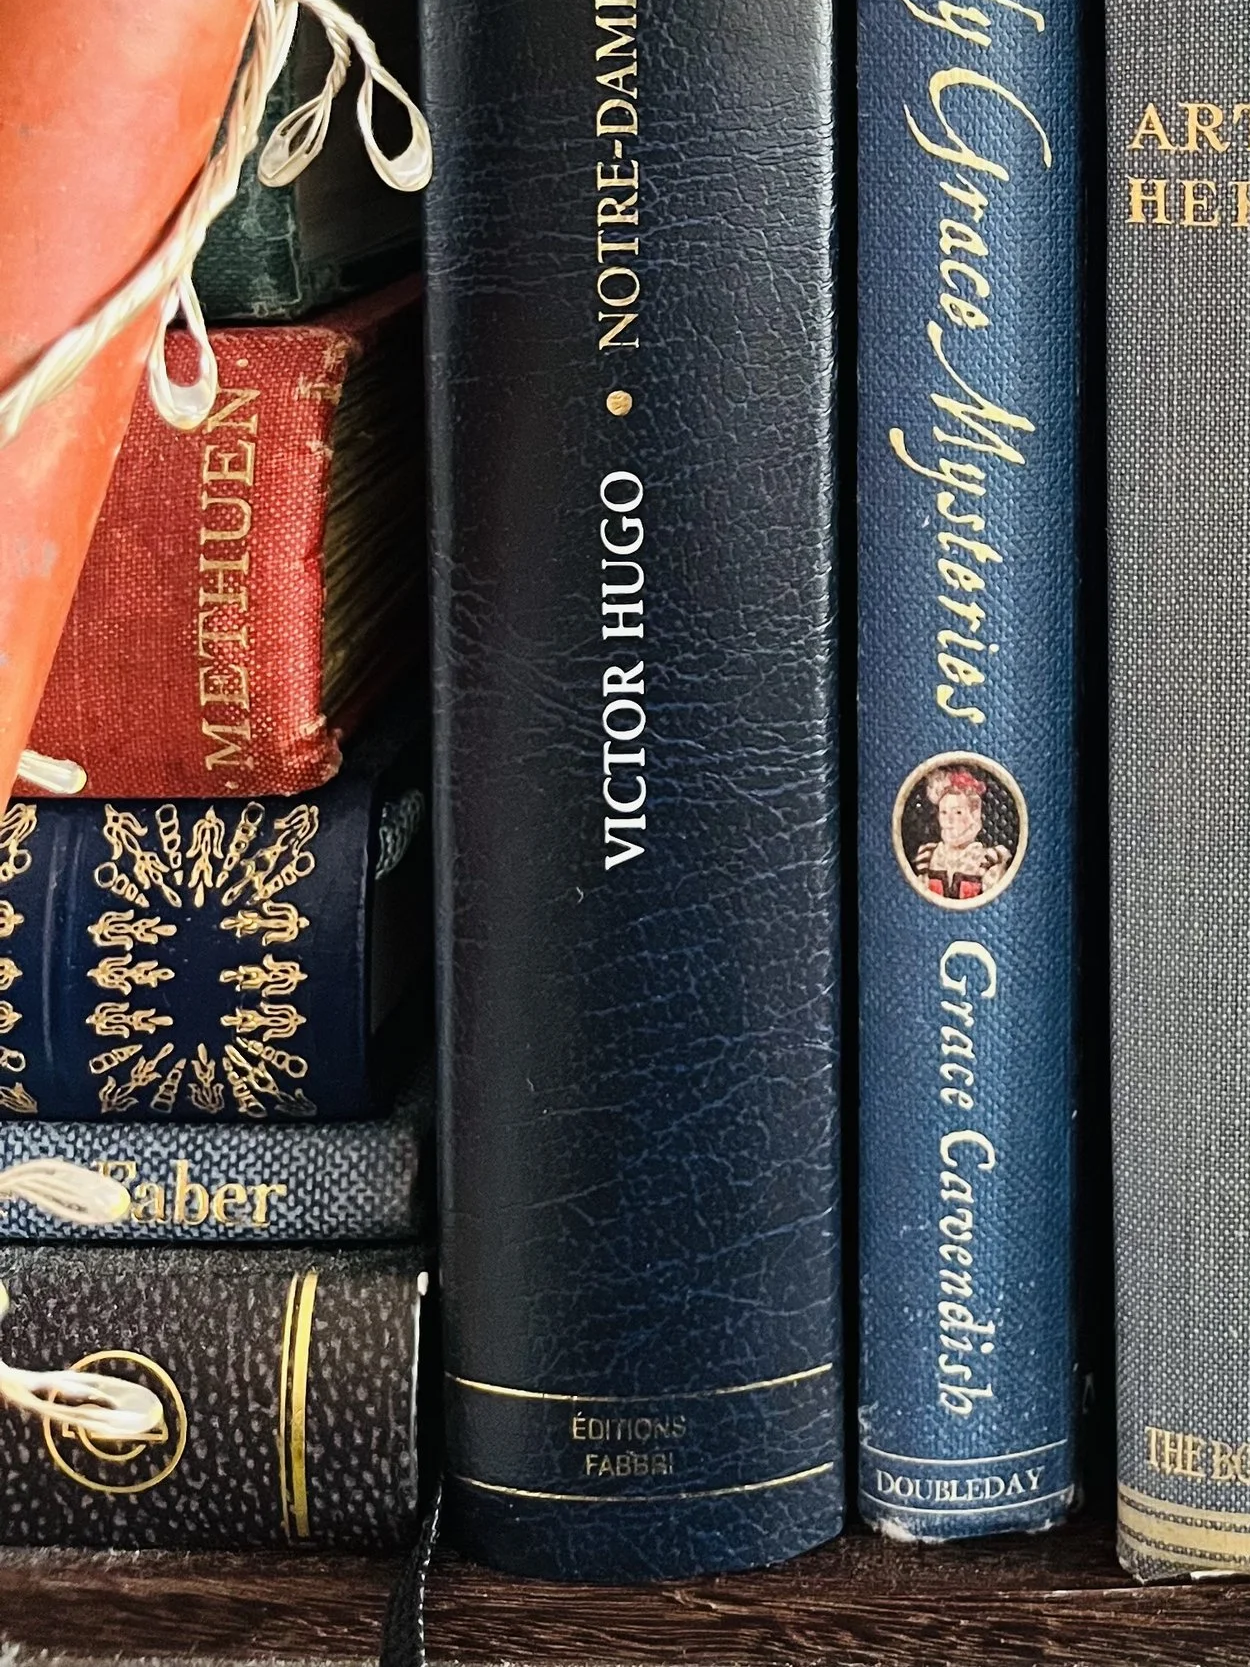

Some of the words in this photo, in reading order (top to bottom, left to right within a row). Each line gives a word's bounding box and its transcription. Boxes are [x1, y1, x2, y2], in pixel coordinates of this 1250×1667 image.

[903, 67, 1053, 328] Grace
[198, 385, 261, 772] METHUEN
[599, 470, 645, 640] HUGO
[889, 321, 1036, 725] Mysteries
[602, 661, 648, 871] VICTOR
[937, 940, 997, 1111] Grace
[937, 1131, 997, 1419] Cavendish
[571, 1411, 687, 1442] ÉDITIONS
[585, 1451, 674, 1476] FABBRI
[876, 1465, 1046, 1502] DOUBLEDAY
[1145, 1425, 1206, 1479] THE
